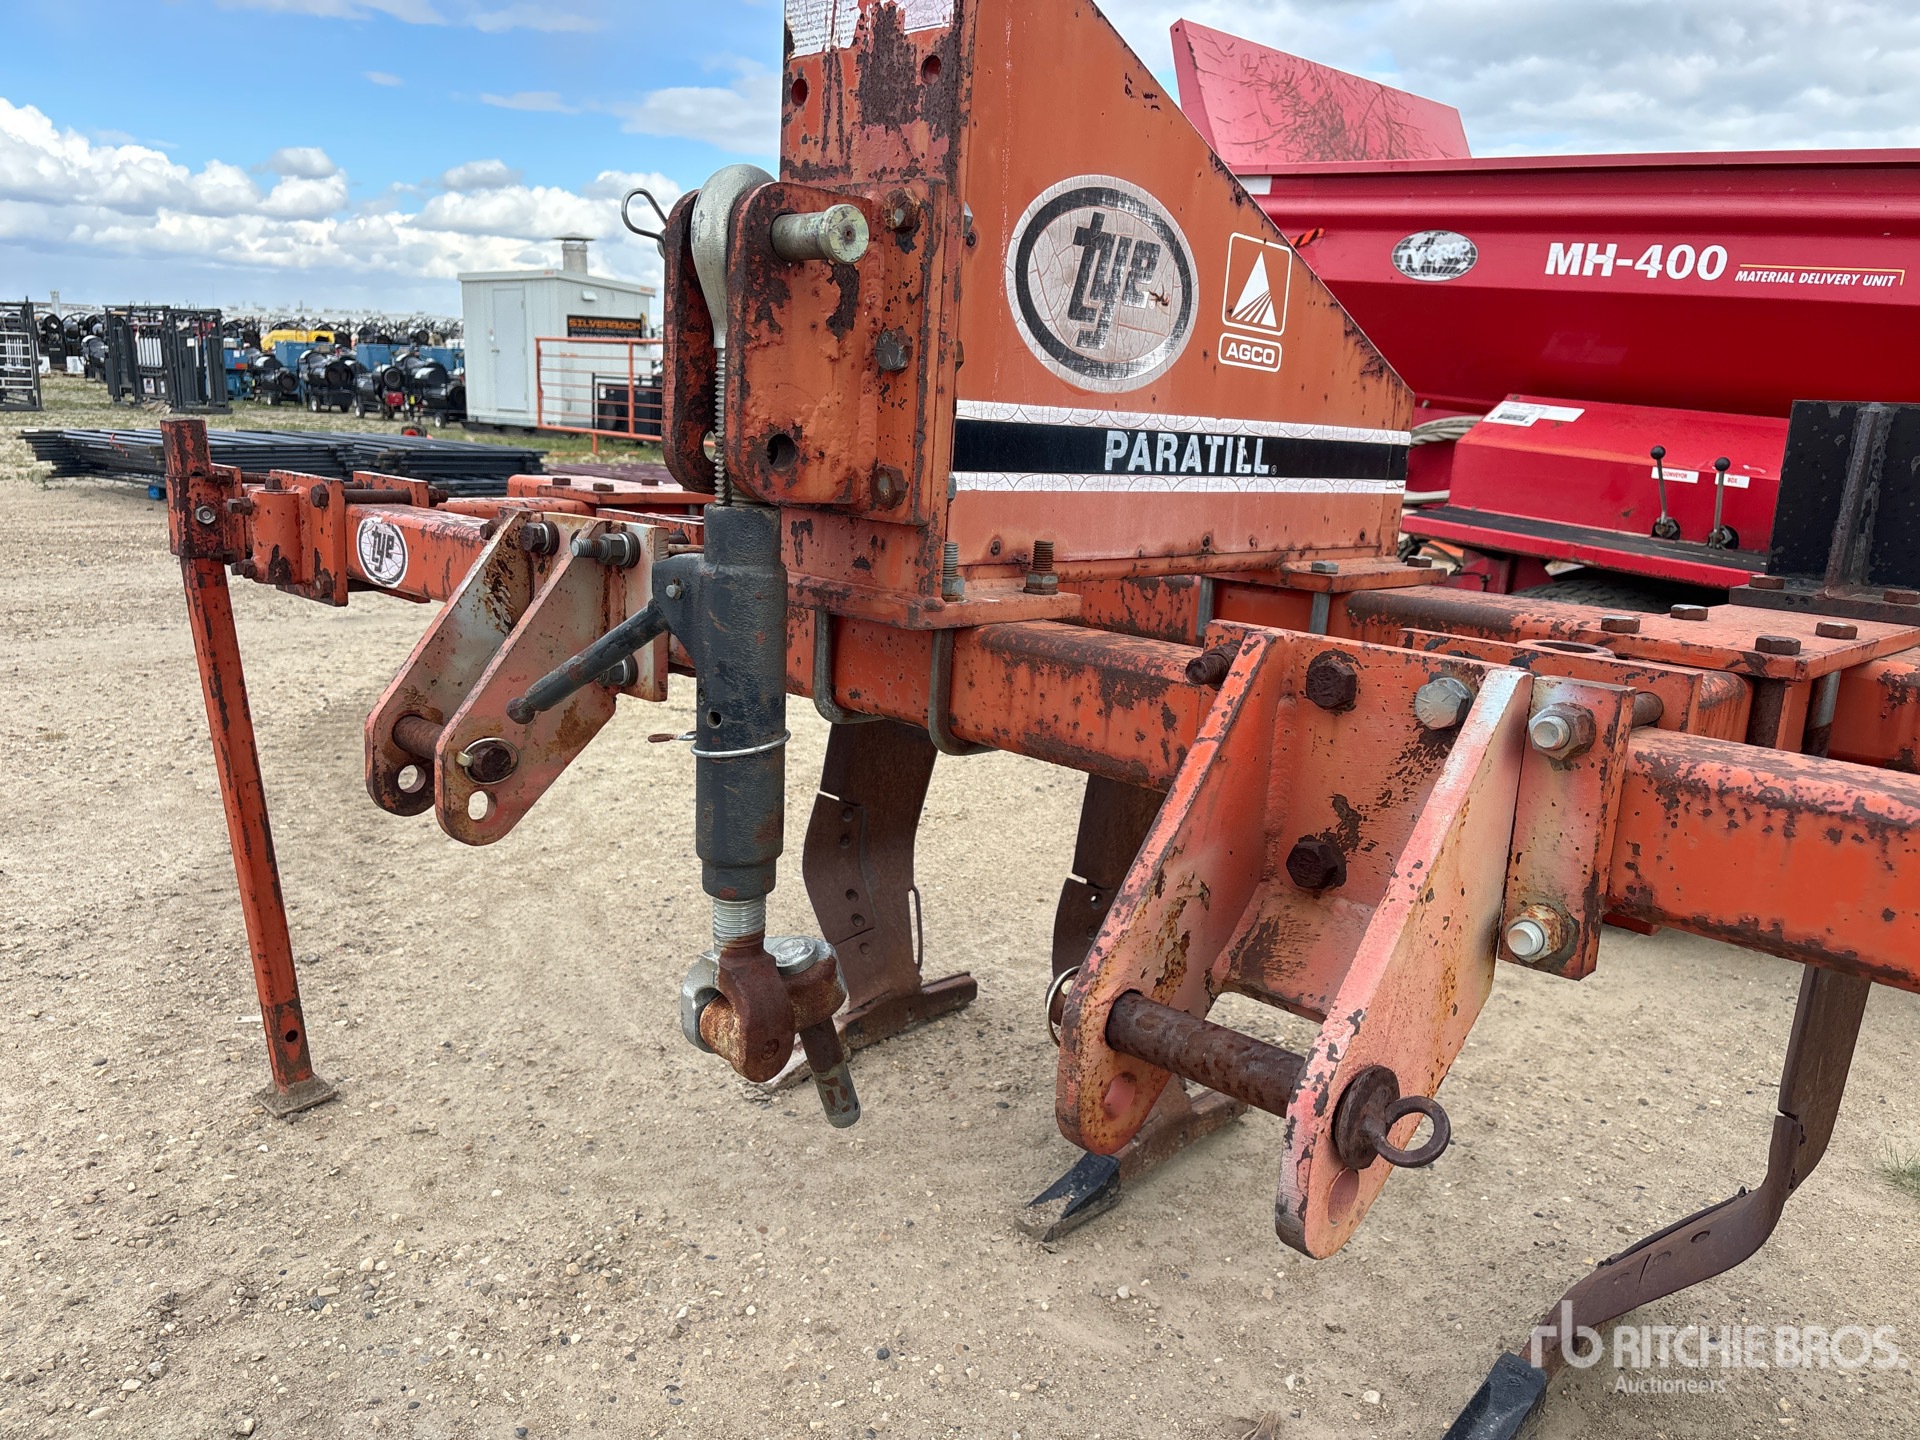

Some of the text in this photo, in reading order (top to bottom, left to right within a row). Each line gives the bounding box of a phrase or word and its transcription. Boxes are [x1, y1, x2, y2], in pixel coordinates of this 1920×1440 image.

[1545, 242, 1728, 281] MH-400
[1735, 271, 1896, 288] MATERIAL DELIVERY UNIT
[1225, 342, 1276, 365] AGCO
[1104, 430, 1270, 475] PARATILL
[1663, 471, 1688, 479] CONVEYOR
